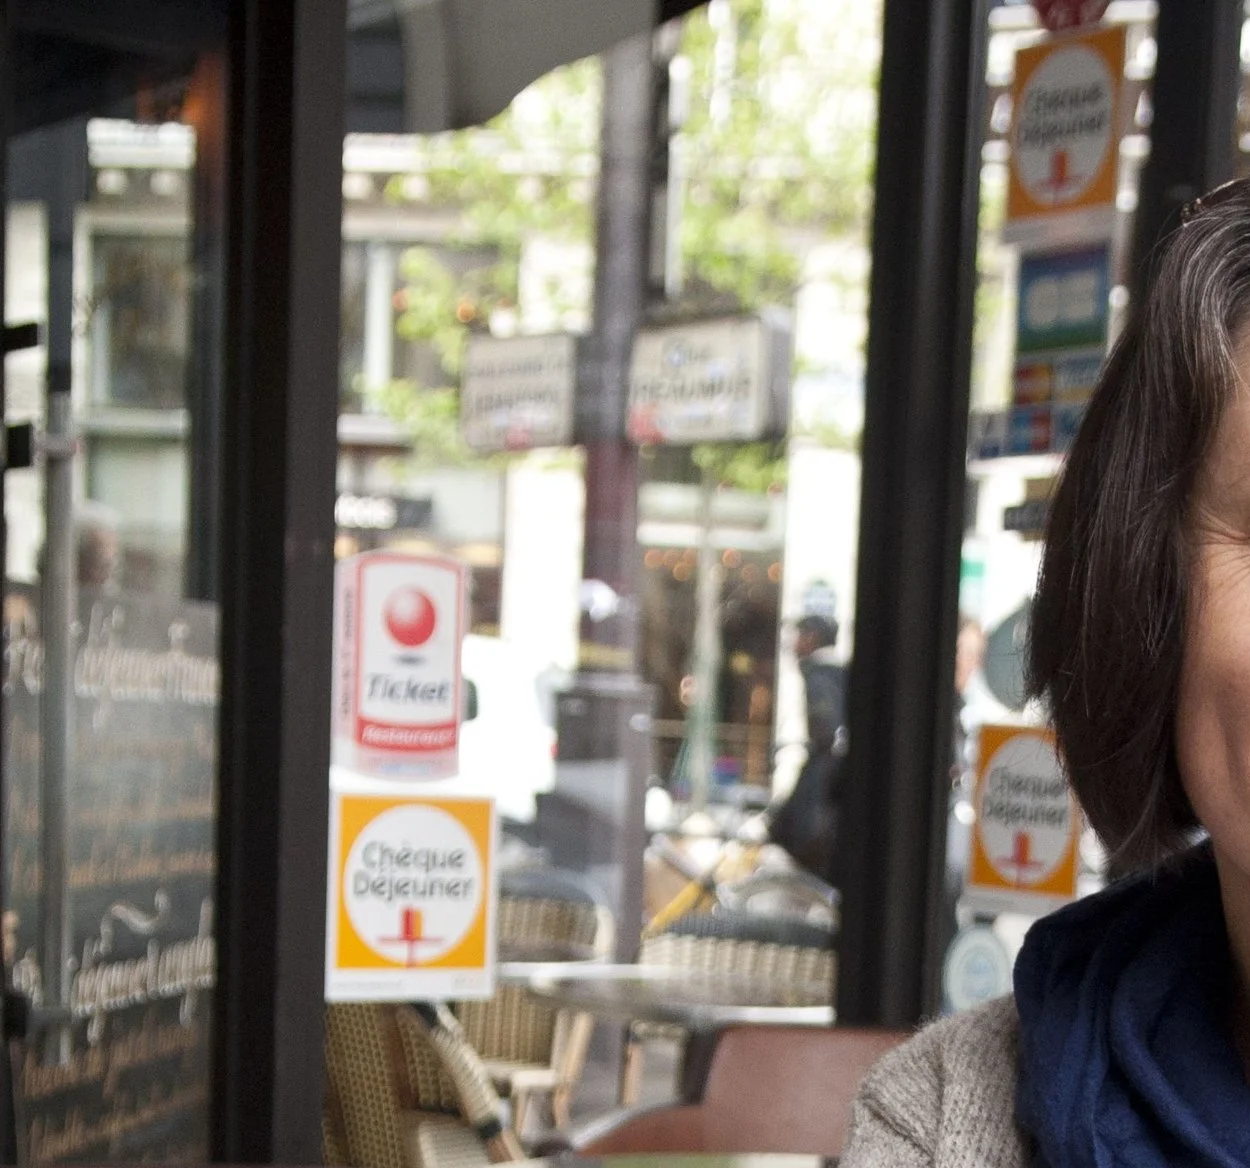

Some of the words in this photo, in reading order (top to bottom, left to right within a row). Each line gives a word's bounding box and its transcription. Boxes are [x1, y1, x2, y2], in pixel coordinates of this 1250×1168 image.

[368, 671, 451, 703] Ticket
[361, 840, 467, 874] Chèque
[352, 867, 476, 904] Déjeuner
